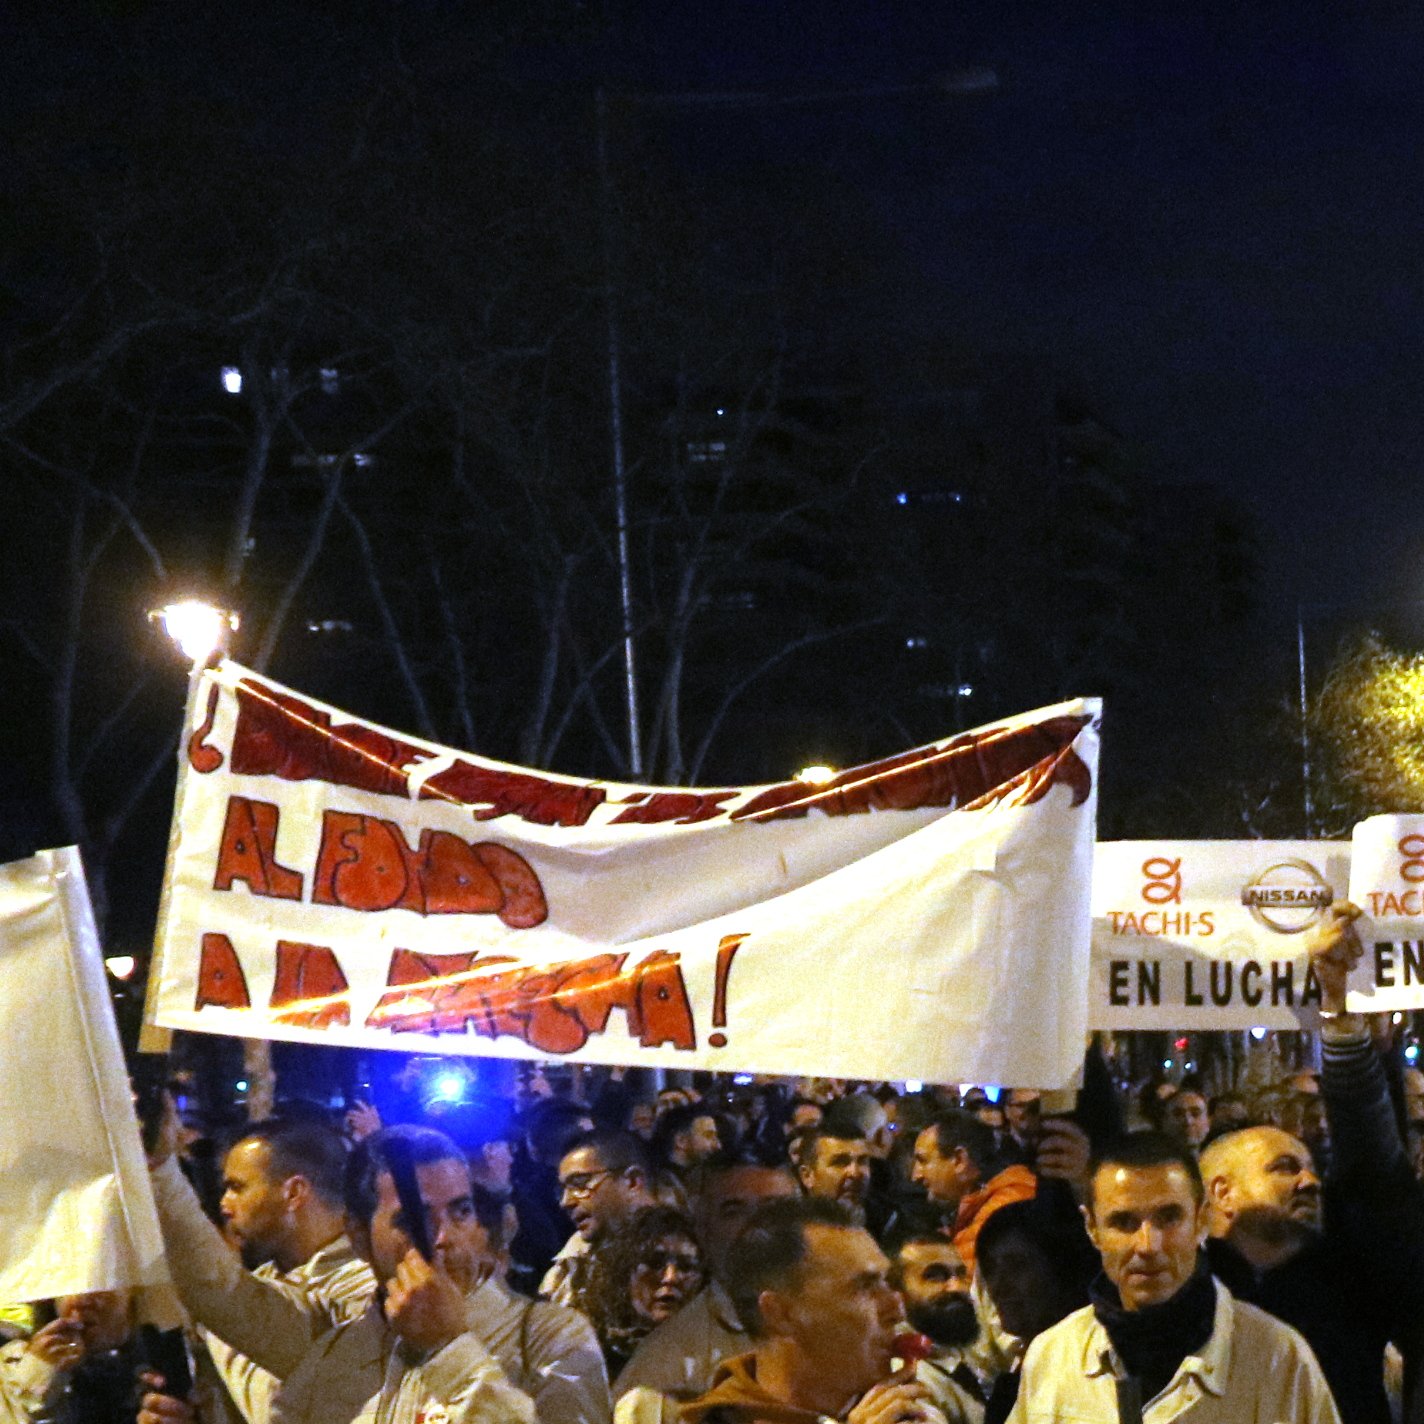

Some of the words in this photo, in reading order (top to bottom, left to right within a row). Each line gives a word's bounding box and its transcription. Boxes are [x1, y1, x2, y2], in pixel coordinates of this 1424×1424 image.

[213, 796, 304, 904] AL
[1249, 889, 1325, 902] NISSAN
[1106, 910, 1215, 937] TACHI-S
[1109, 960, 1161, 1007] EN
[1184, 960, 1323, 1007] LUCHA
